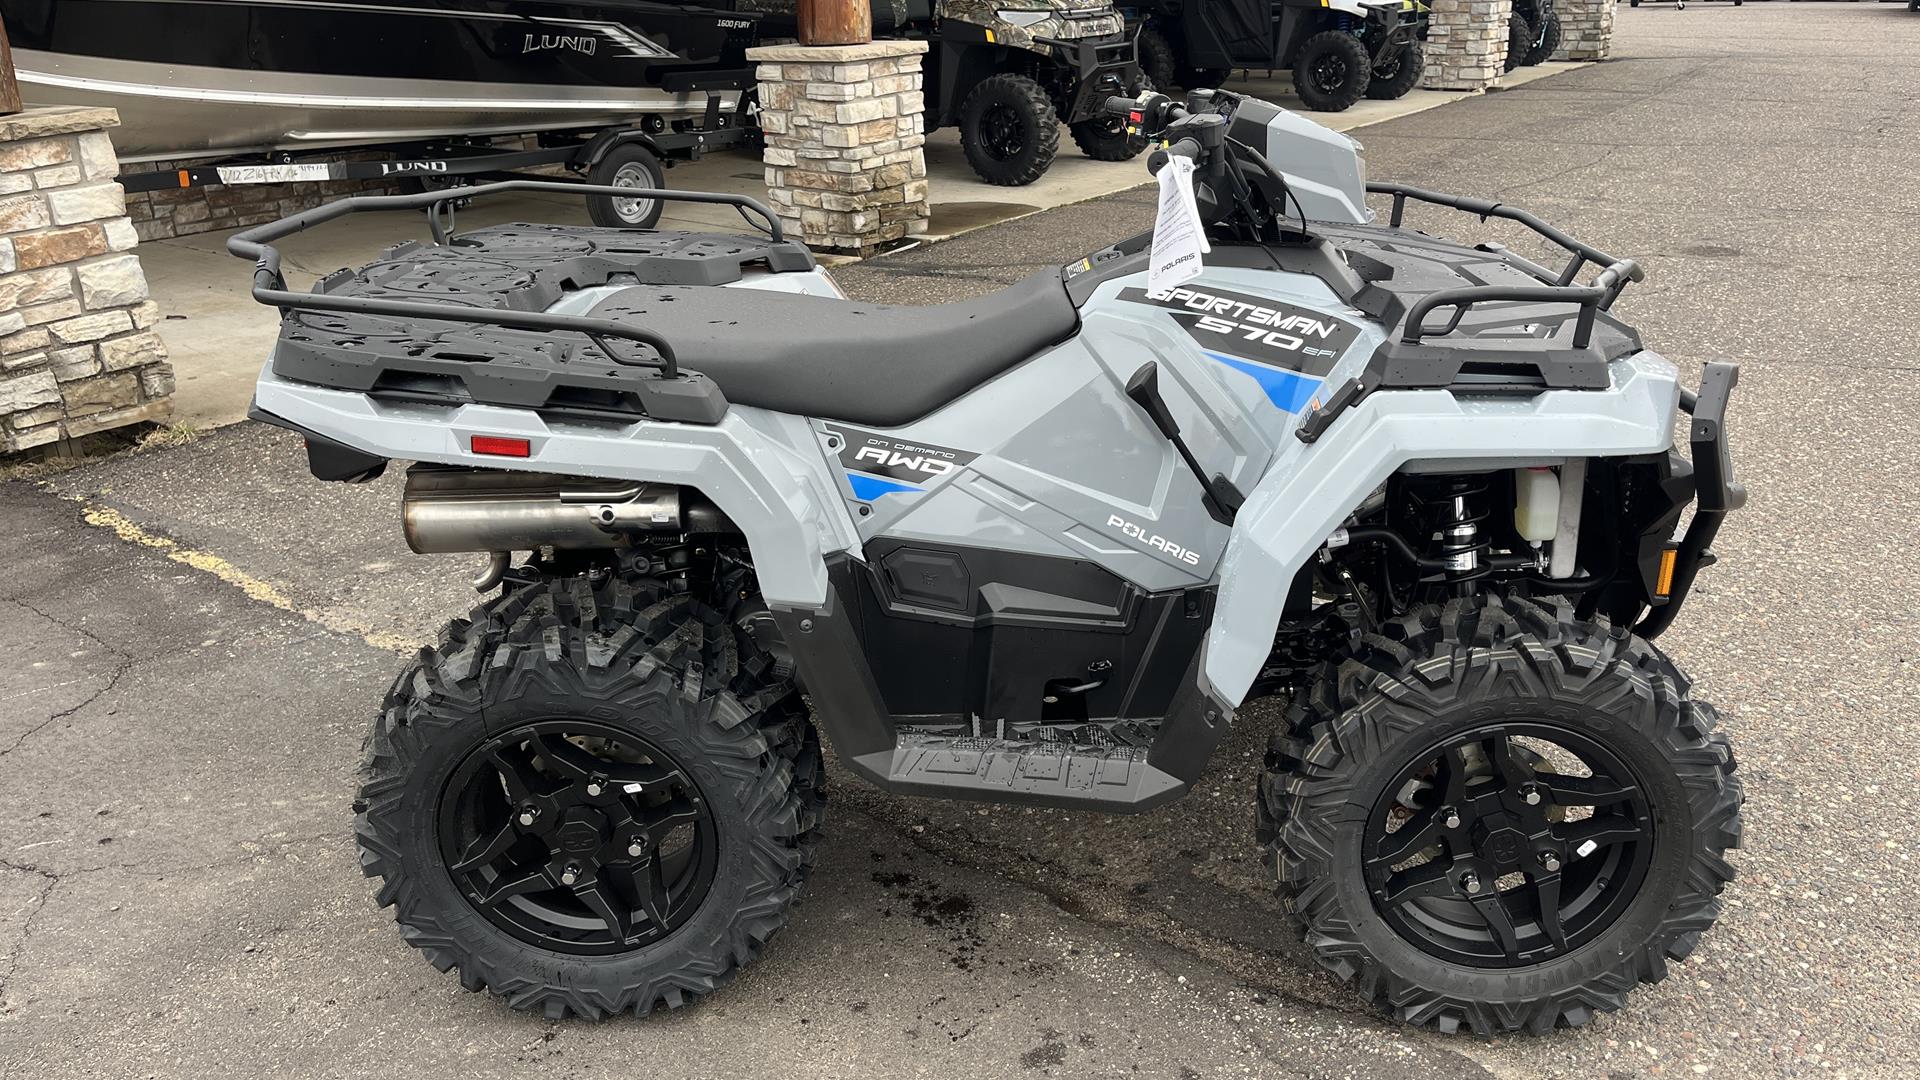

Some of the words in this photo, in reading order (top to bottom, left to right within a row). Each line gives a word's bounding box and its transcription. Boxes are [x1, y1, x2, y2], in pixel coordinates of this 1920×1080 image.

[717, 19, 734, 28] 1600
[733, 20, 751, 30] FURY
[522, 33, 597, 56] LUND
[381, 161, 447, 177] LUND
[1161, 252, 1196, 273] POLARIS
[1150, 286, 1337, 339] SPORTSMAN
[1194, 315, 1304, 351] 570
[1302, 346, 1336, 358] EFI
[867, 438, 889, 447] ON
[894, 443, 956, 459] DEMAND
[854, 446, 955, 476] AWD
[1106, 514, 1200, 566] POLARIS
